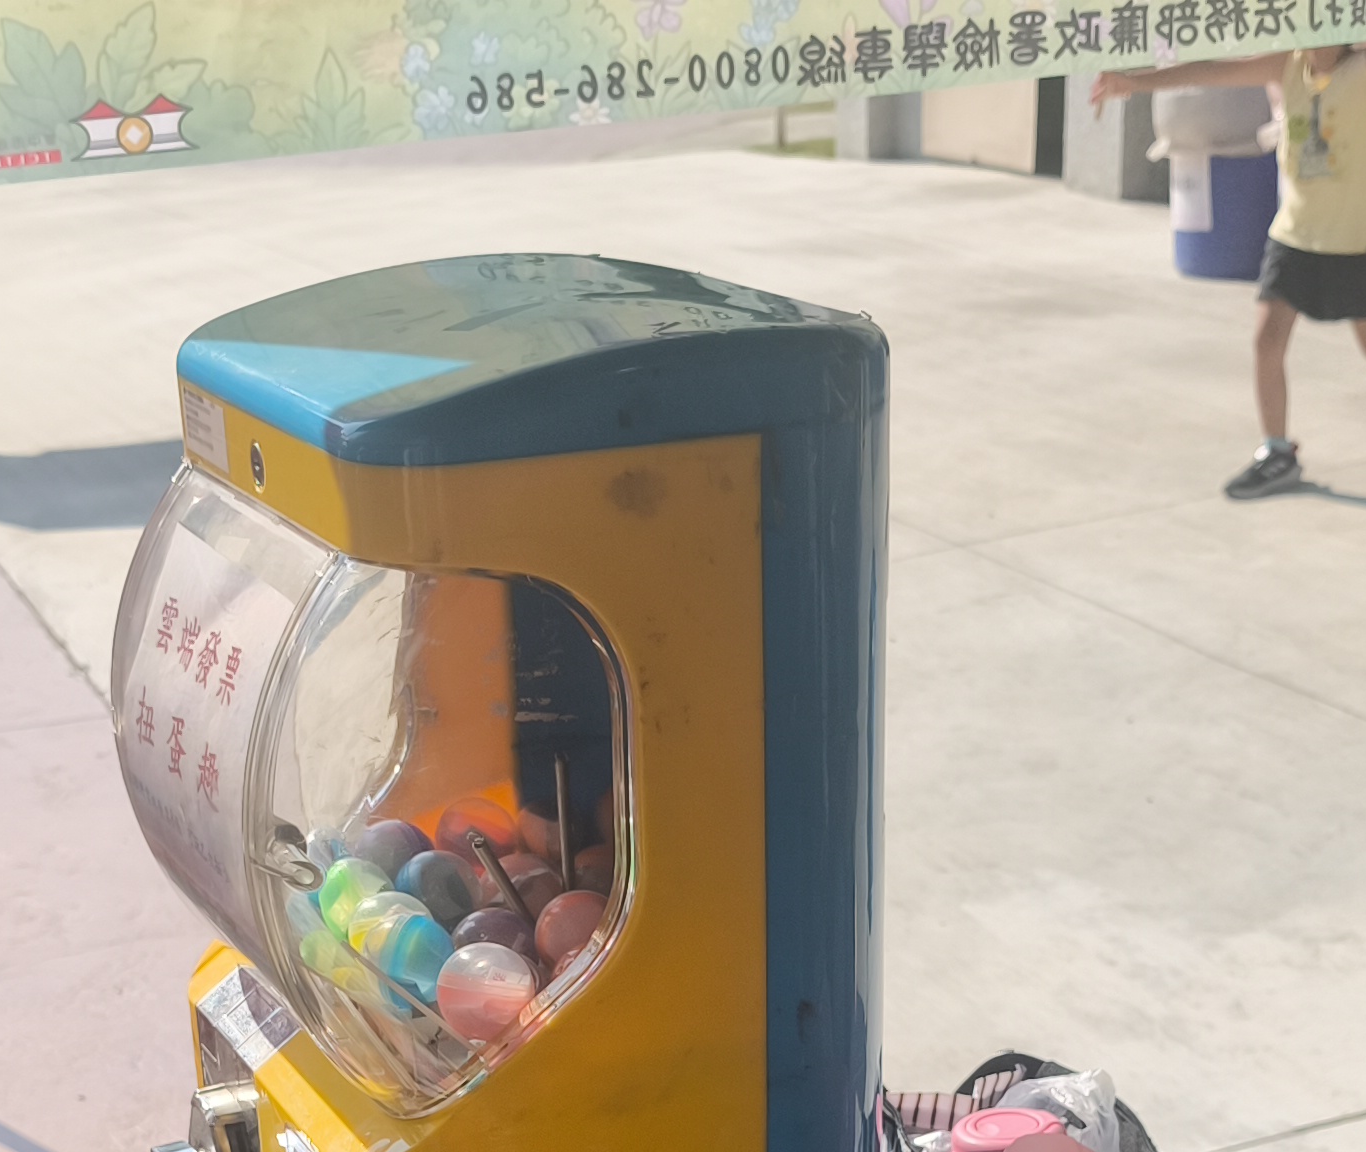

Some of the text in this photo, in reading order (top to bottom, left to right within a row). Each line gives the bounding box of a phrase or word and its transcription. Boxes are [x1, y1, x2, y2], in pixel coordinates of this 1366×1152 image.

[155, 597, 243, 706] 雲端發票
[136, 685, 220, 812] 扭蛋趣
